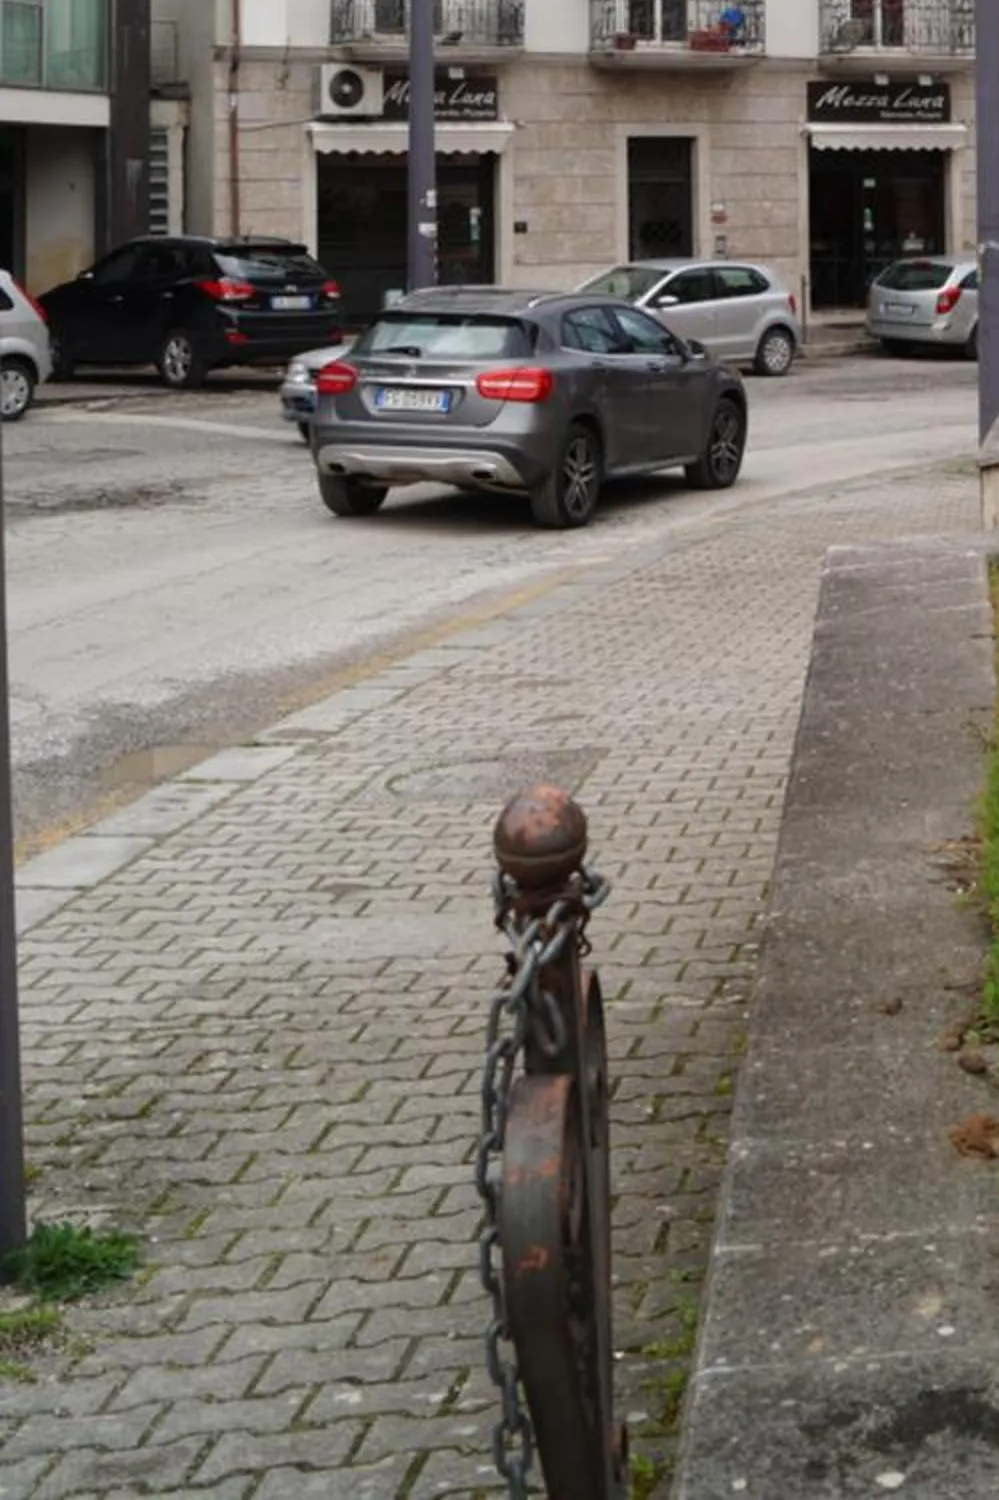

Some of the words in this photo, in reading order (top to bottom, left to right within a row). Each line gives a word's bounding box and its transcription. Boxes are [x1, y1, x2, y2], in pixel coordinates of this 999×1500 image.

[448, 82, 495, 106] Luna
[815, 85, 889, 109] Mezza
[892, 87, 945, 109] Luna
